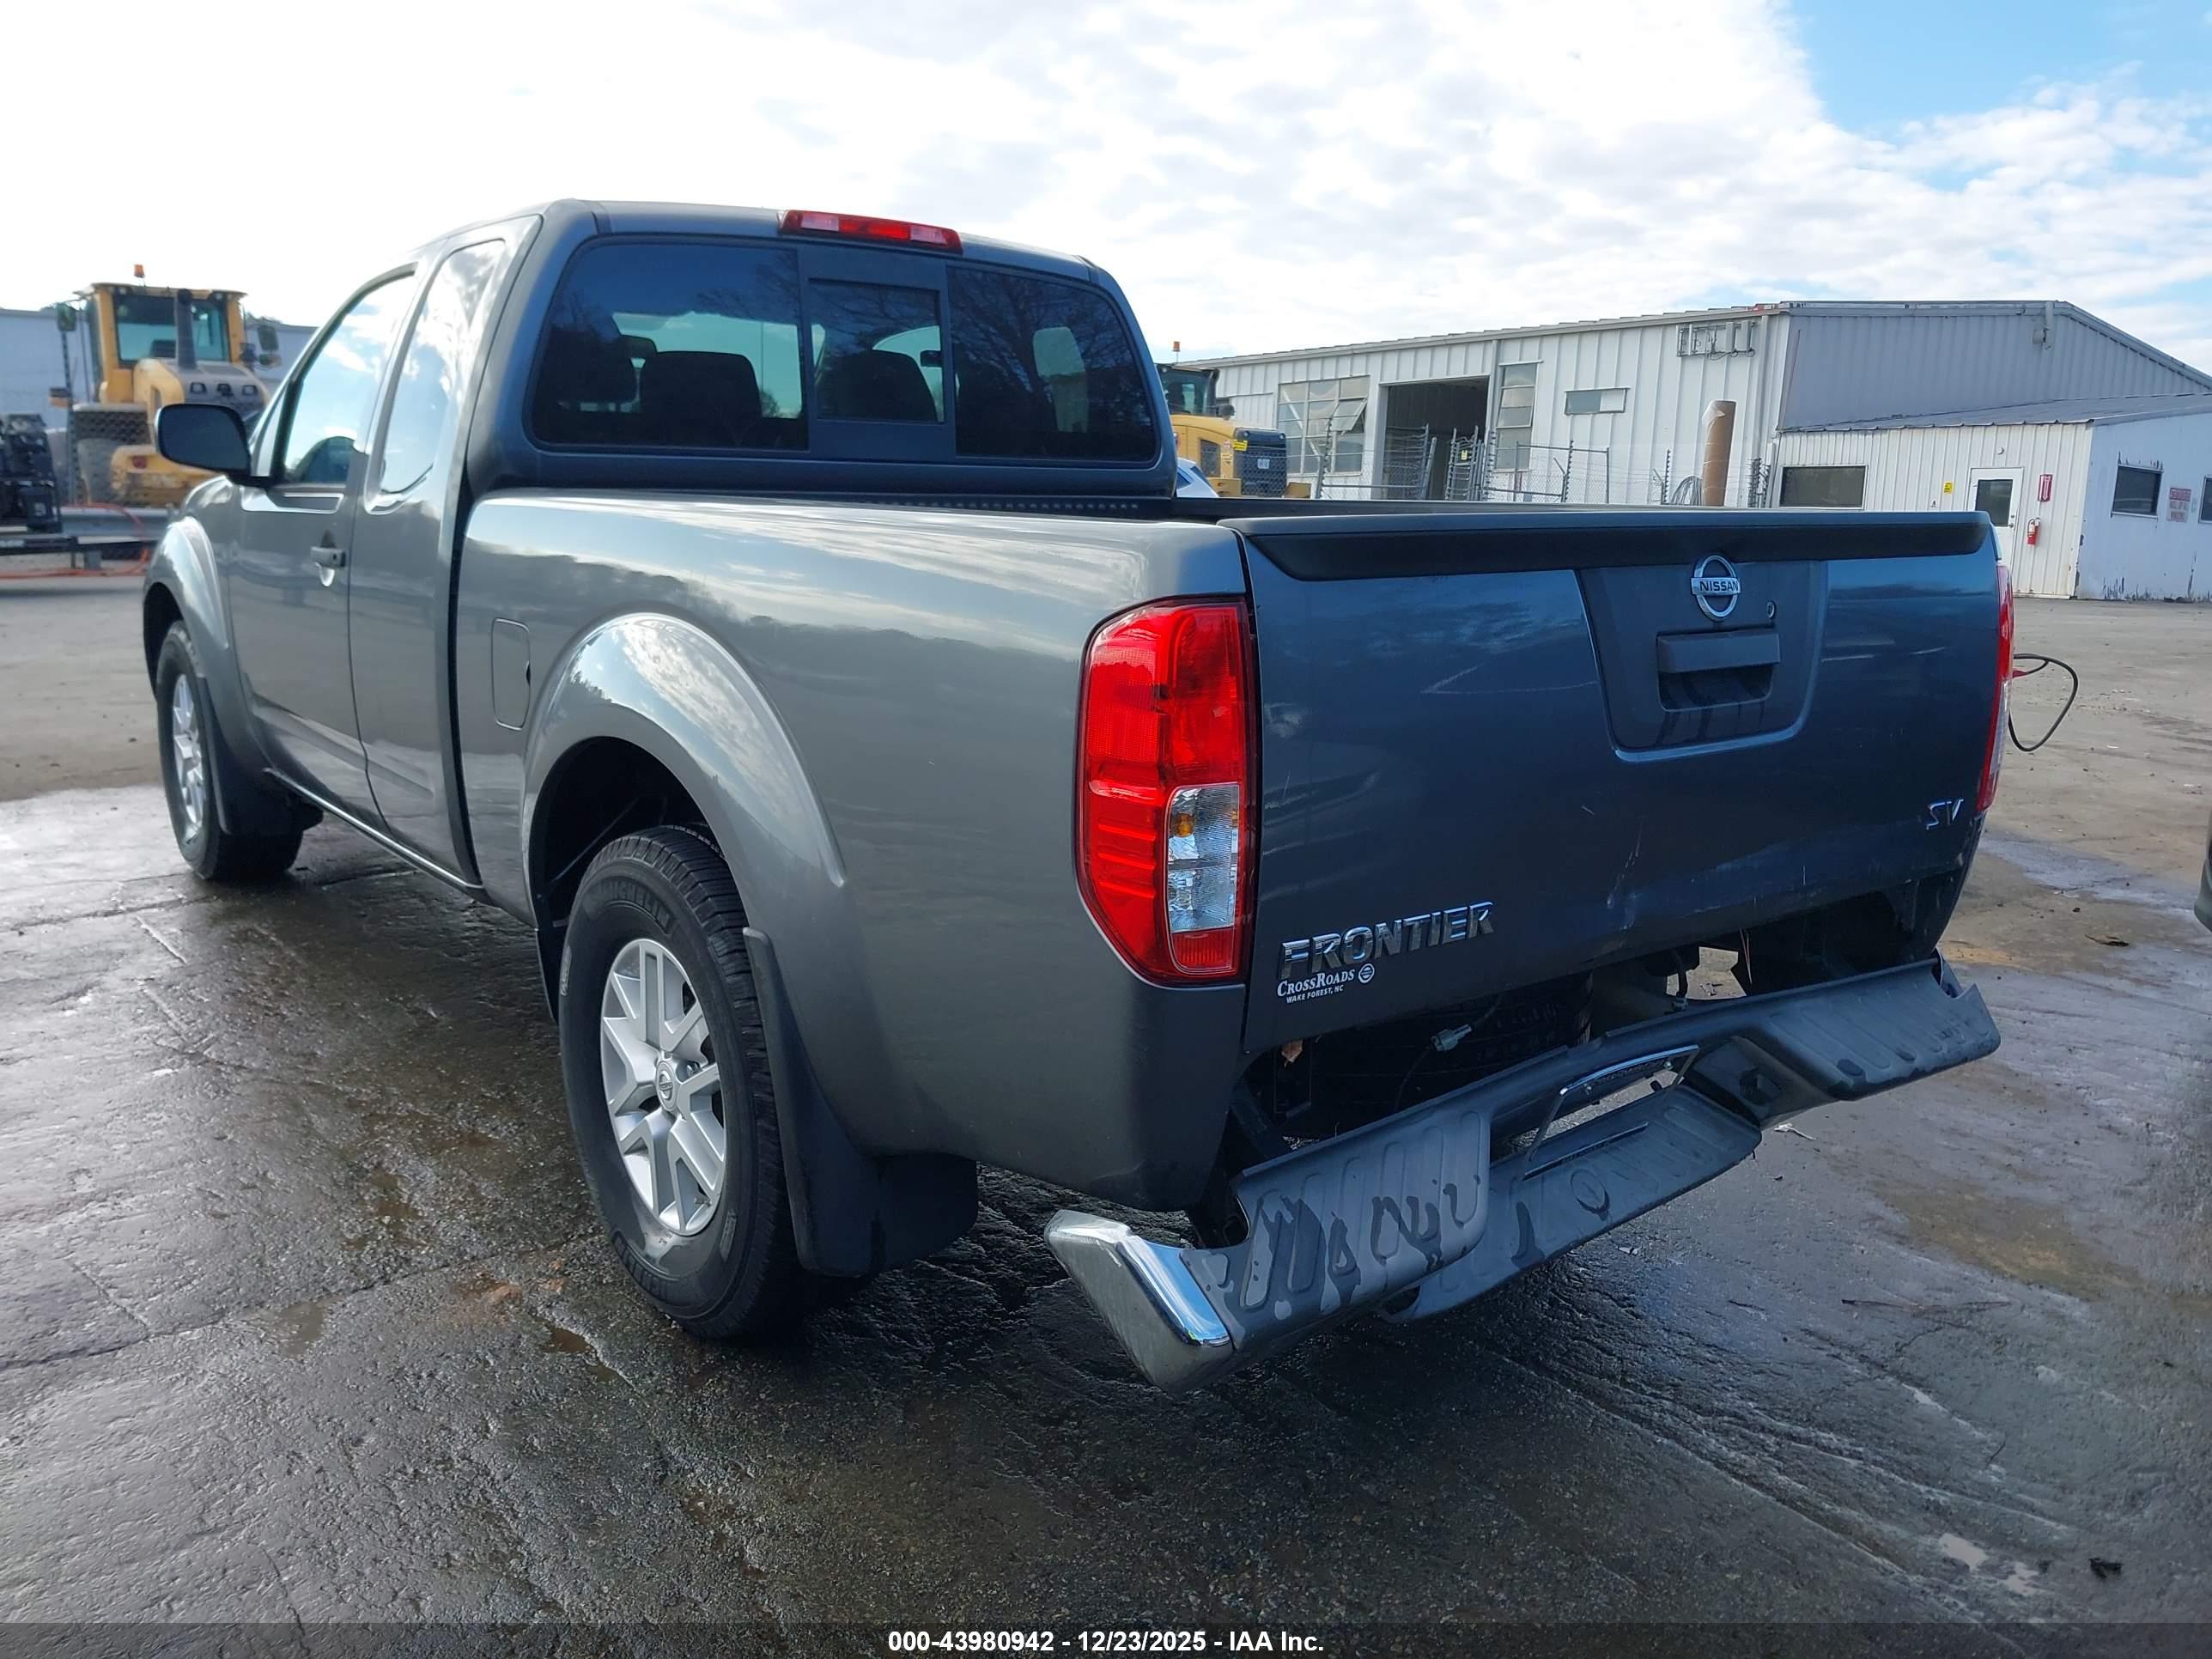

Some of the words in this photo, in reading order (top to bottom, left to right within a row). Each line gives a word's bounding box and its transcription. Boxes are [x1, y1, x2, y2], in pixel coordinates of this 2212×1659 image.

[1700, 580, 1739, 592] NISSAN
[1926, 799, 1964, 830] SV
[1278, 902, 1494, 980] FRONTIER
[1285, 994, 1306, 1004] WAKE
[1334, 984, 1345, 993] NC
